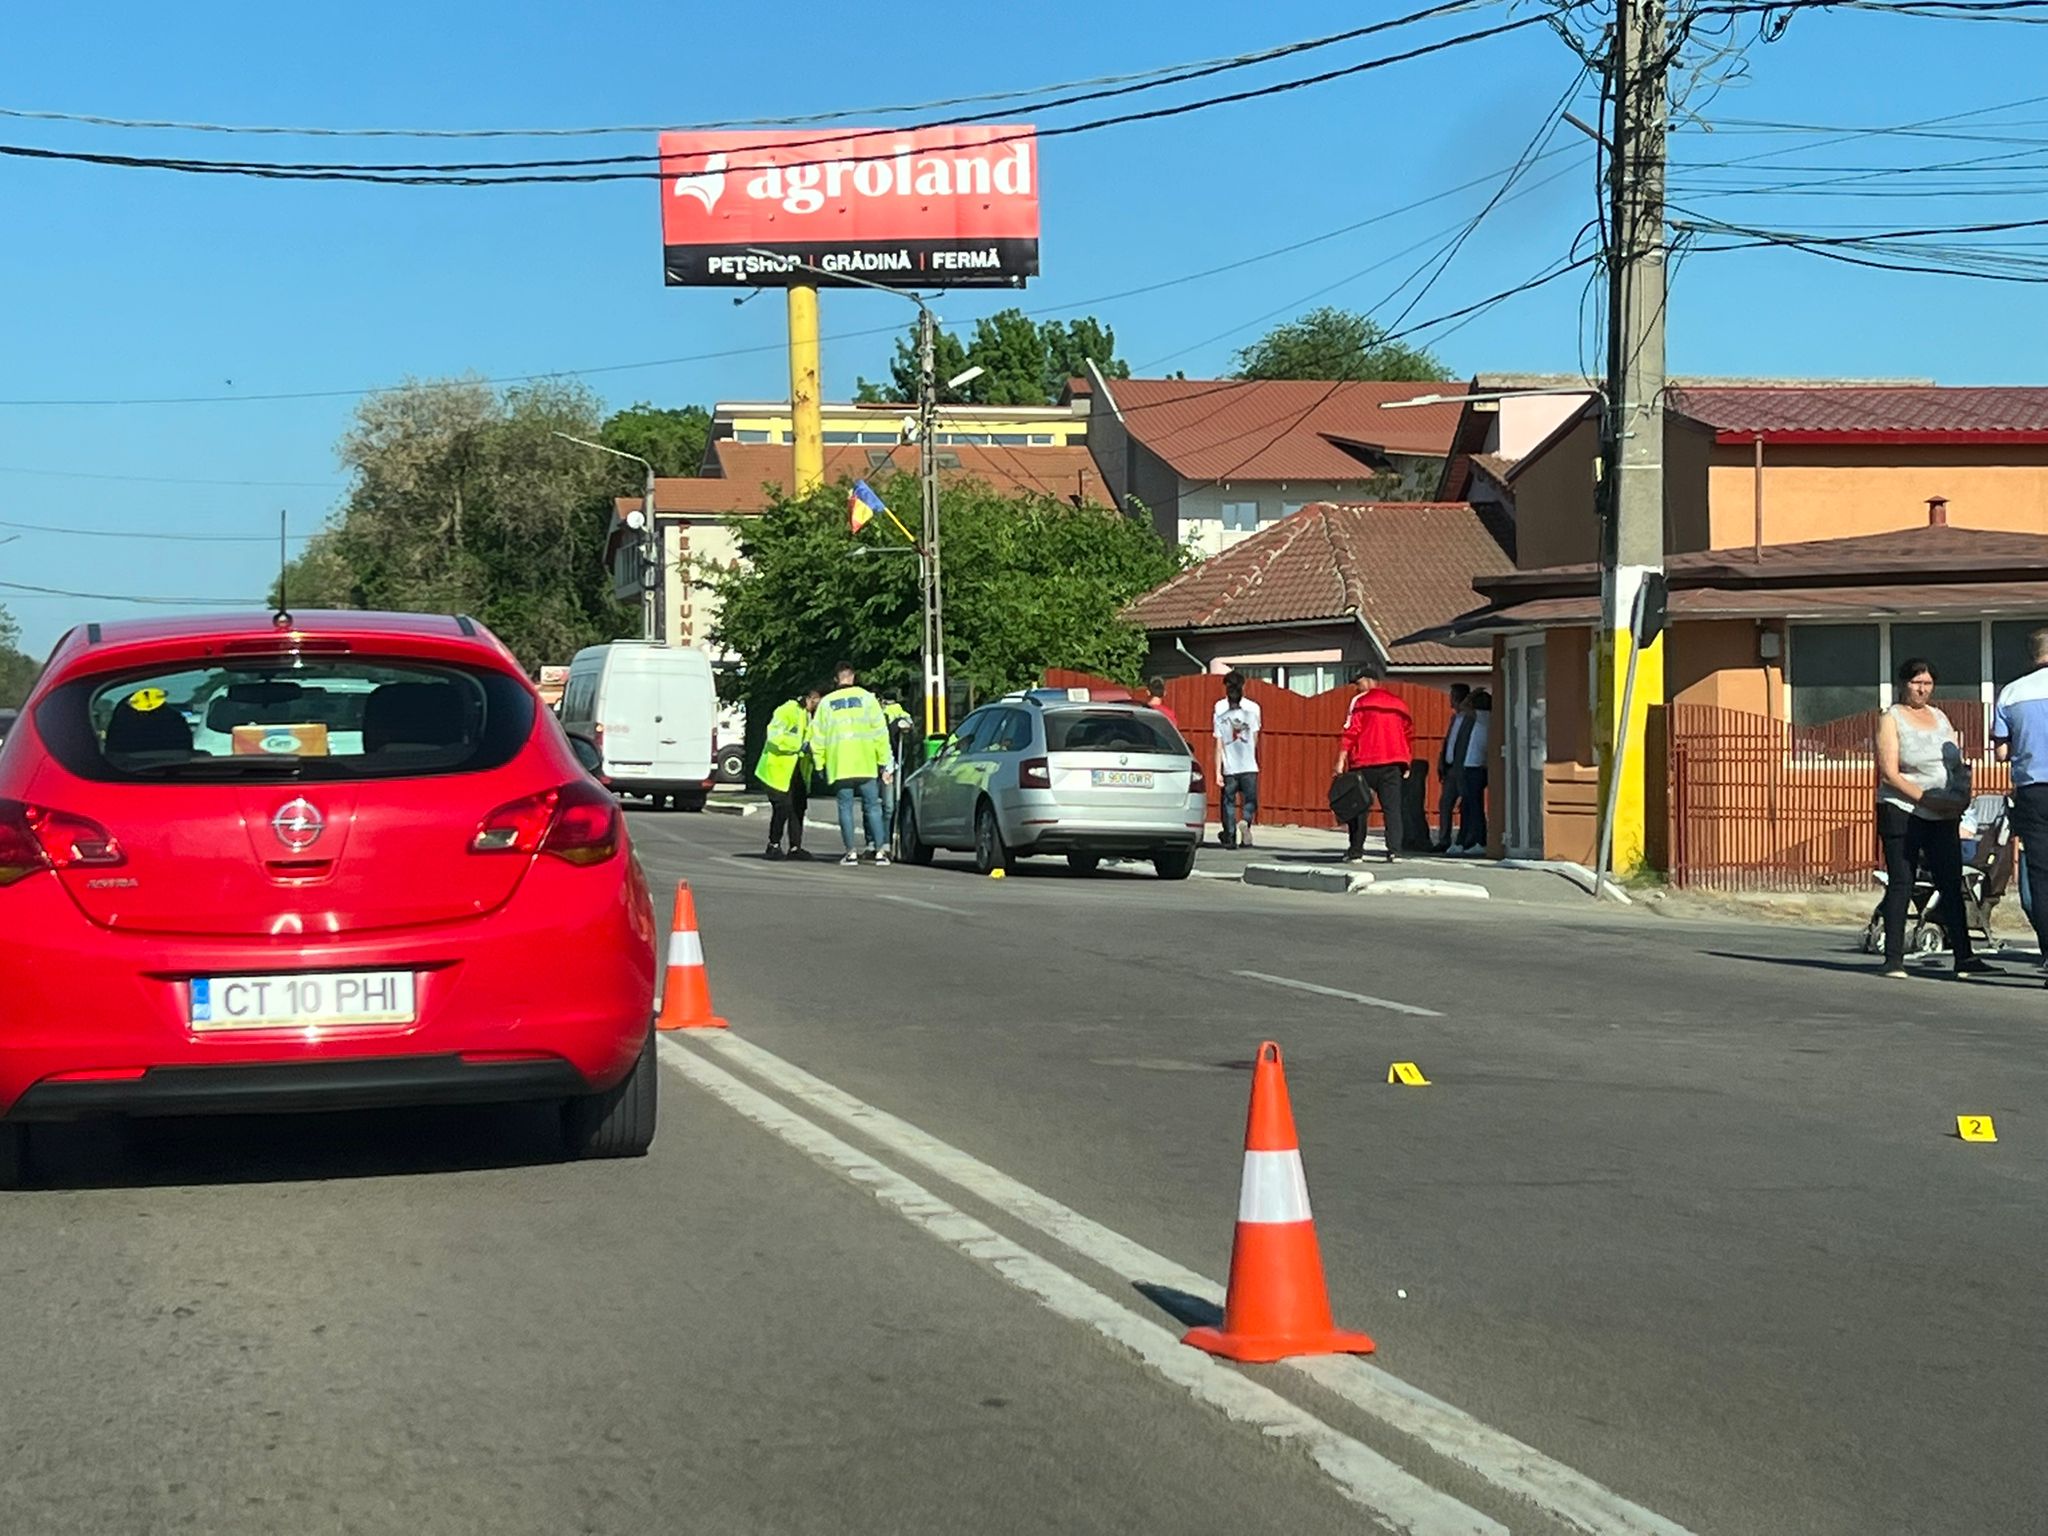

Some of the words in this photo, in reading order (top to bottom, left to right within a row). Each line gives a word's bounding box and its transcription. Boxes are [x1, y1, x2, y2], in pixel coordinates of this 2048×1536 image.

[746, 143, 1031, 214] agroland
[708, 255, 801, 274] PETSHOP
[822, 250, 912, 271] GRĂDINĂ
[932, 248, 1000, 269] FERMĂ
[223, 982, 271, 1016] CT
[286, 981, 322, 1014] 10
[335, 977, 397, 1013] PHI
[1969, 1119, 1984, 1136] 2
